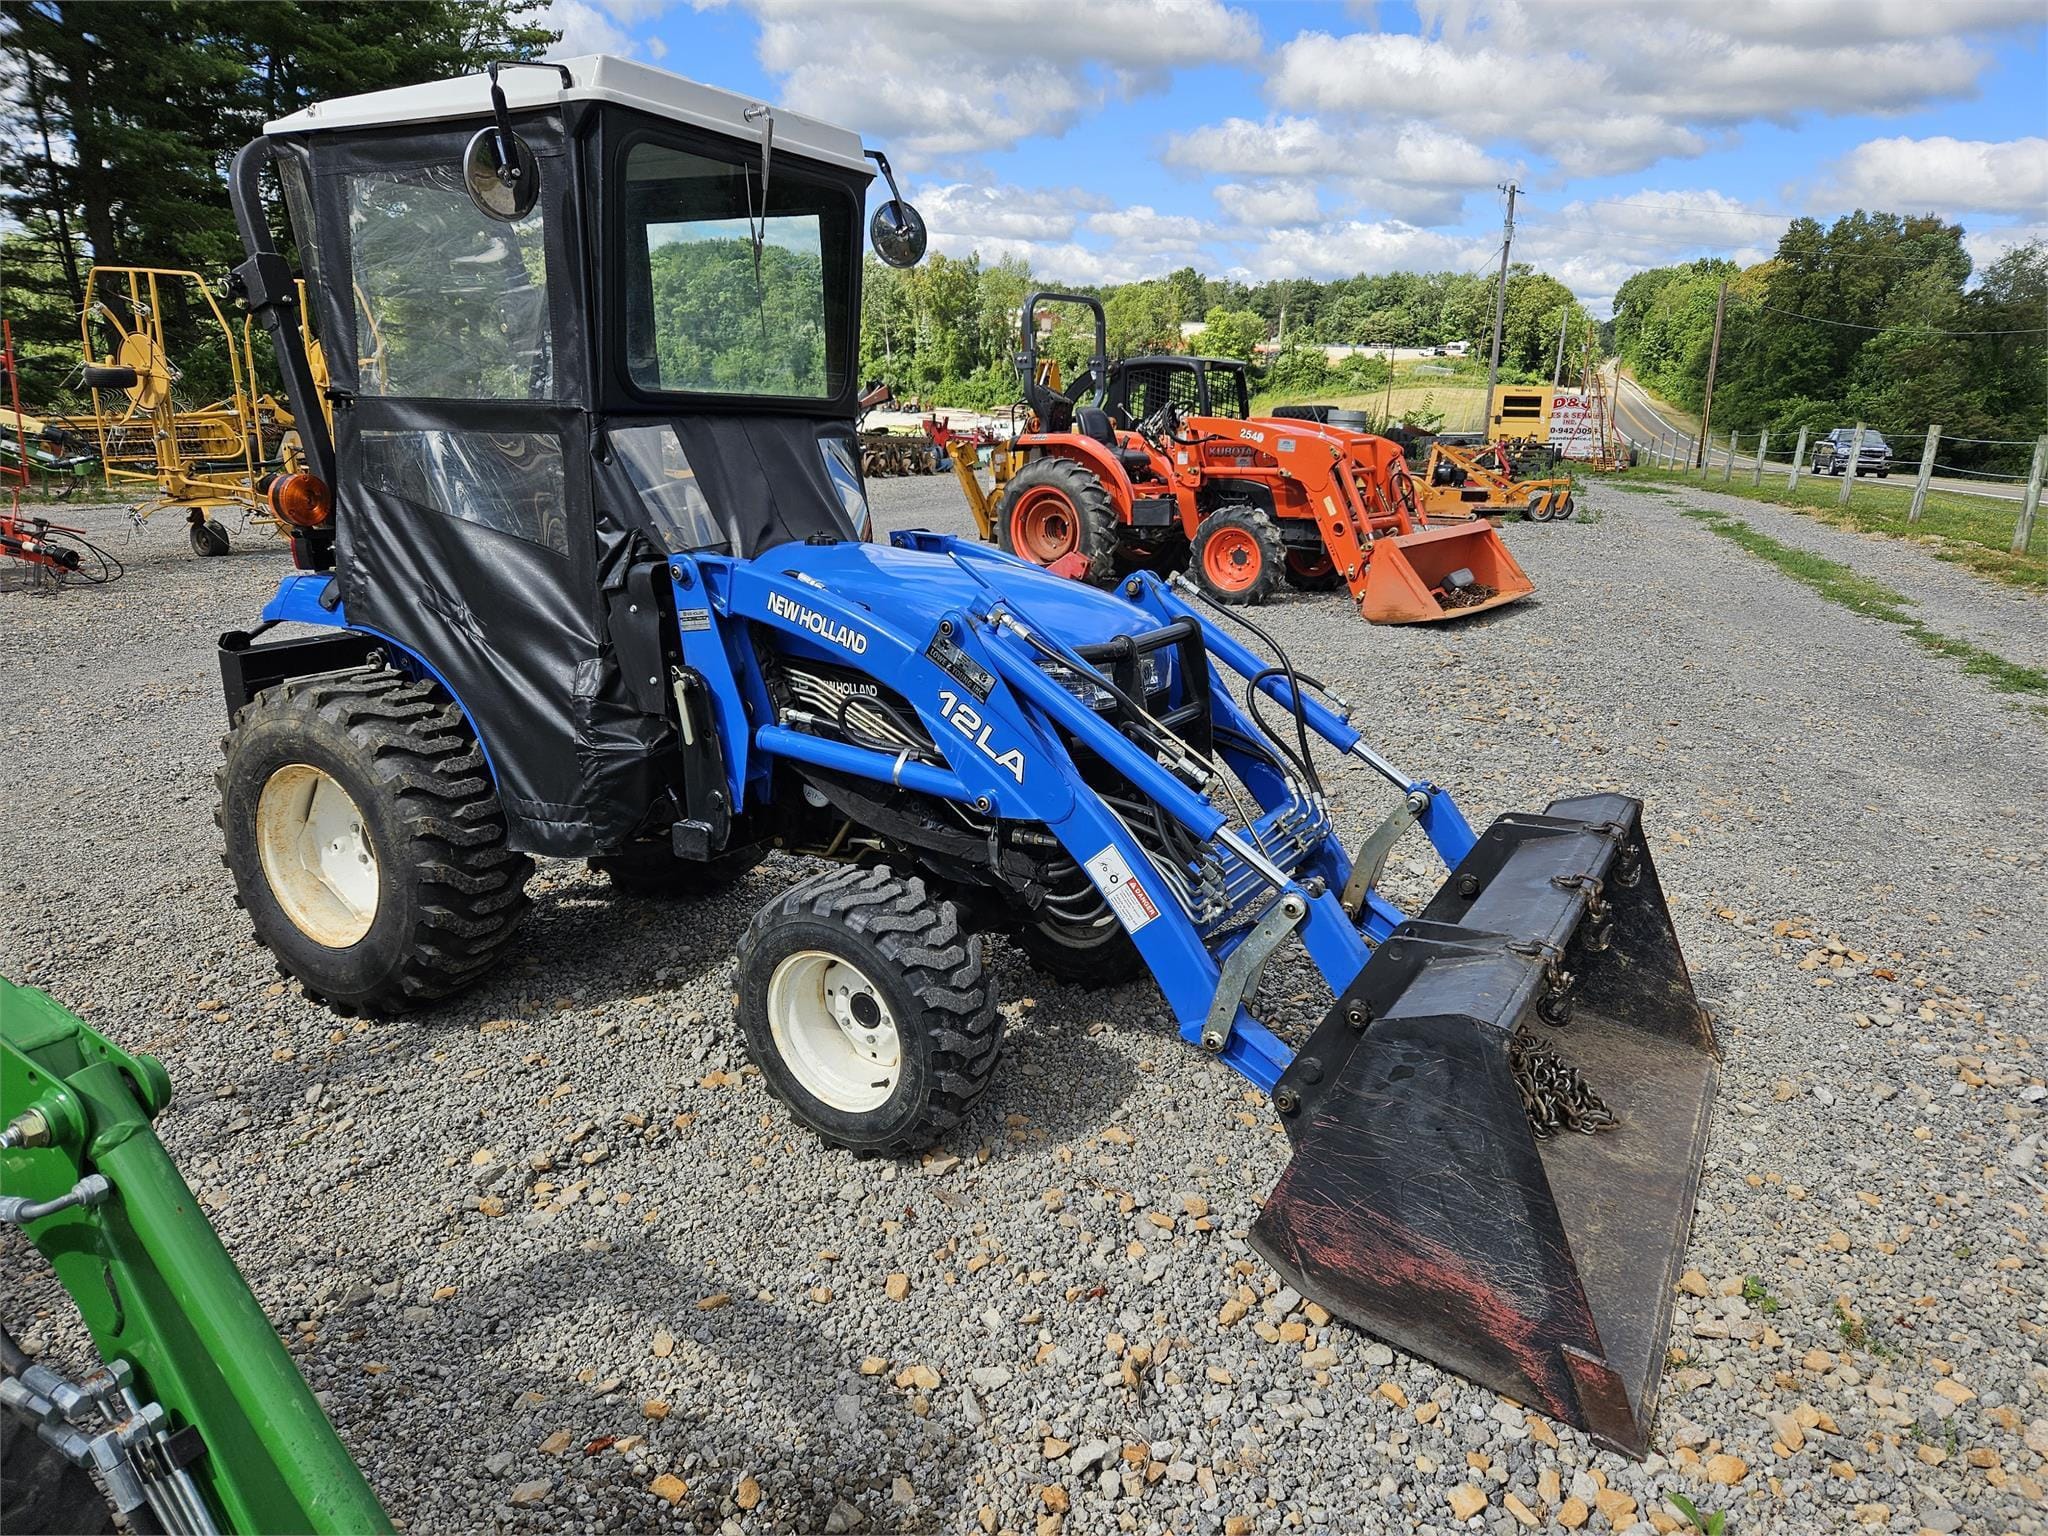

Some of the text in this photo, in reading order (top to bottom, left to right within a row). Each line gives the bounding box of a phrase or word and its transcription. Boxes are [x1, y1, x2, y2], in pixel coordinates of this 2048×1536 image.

[1208, 446, 1254, 457] KUBOTA
[767, 591, 867, 654] NEW HOLLAND
[836, 681, 877, 697] HOLLAND
[951, 666, 973, 688] YOUNG
[939, 691, 1025, 784] 12LA
[1135, 887, 1156, 916] DANGER
